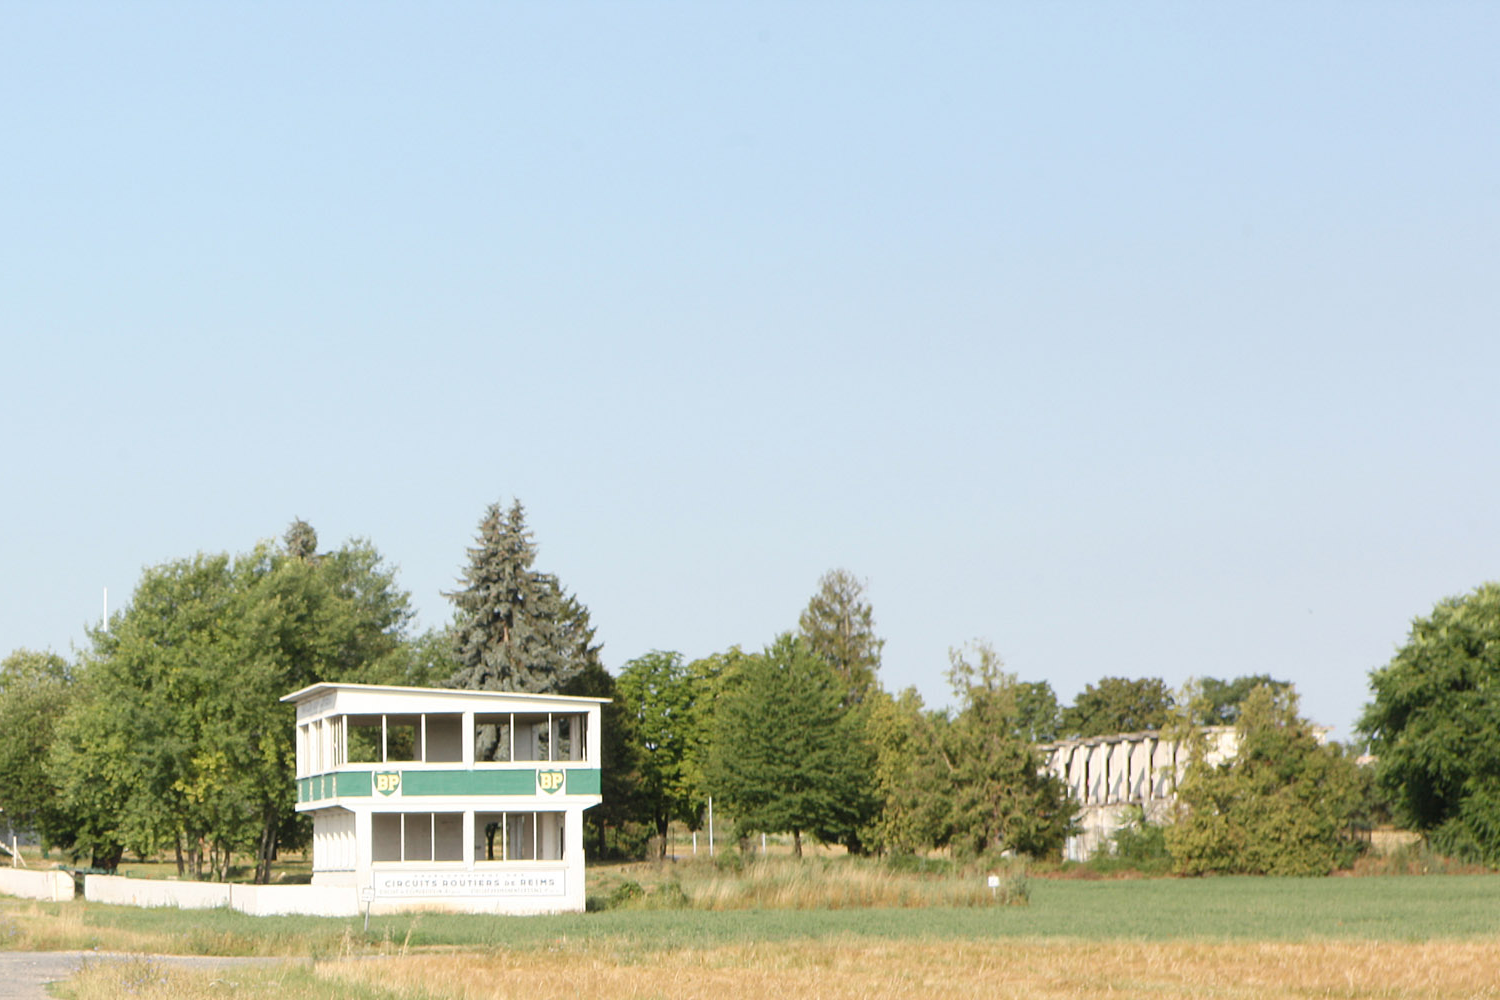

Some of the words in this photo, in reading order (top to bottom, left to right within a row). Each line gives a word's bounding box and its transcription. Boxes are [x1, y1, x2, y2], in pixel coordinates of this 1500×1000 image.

[377, 774, 400, 791] BP
[540, 772, 564, 789] BP
[385, 879, 438, 888] CIRCUITS
[443, 879, 500, 887] ROUTIERS
[520, 879, 555, 887] REIMS
